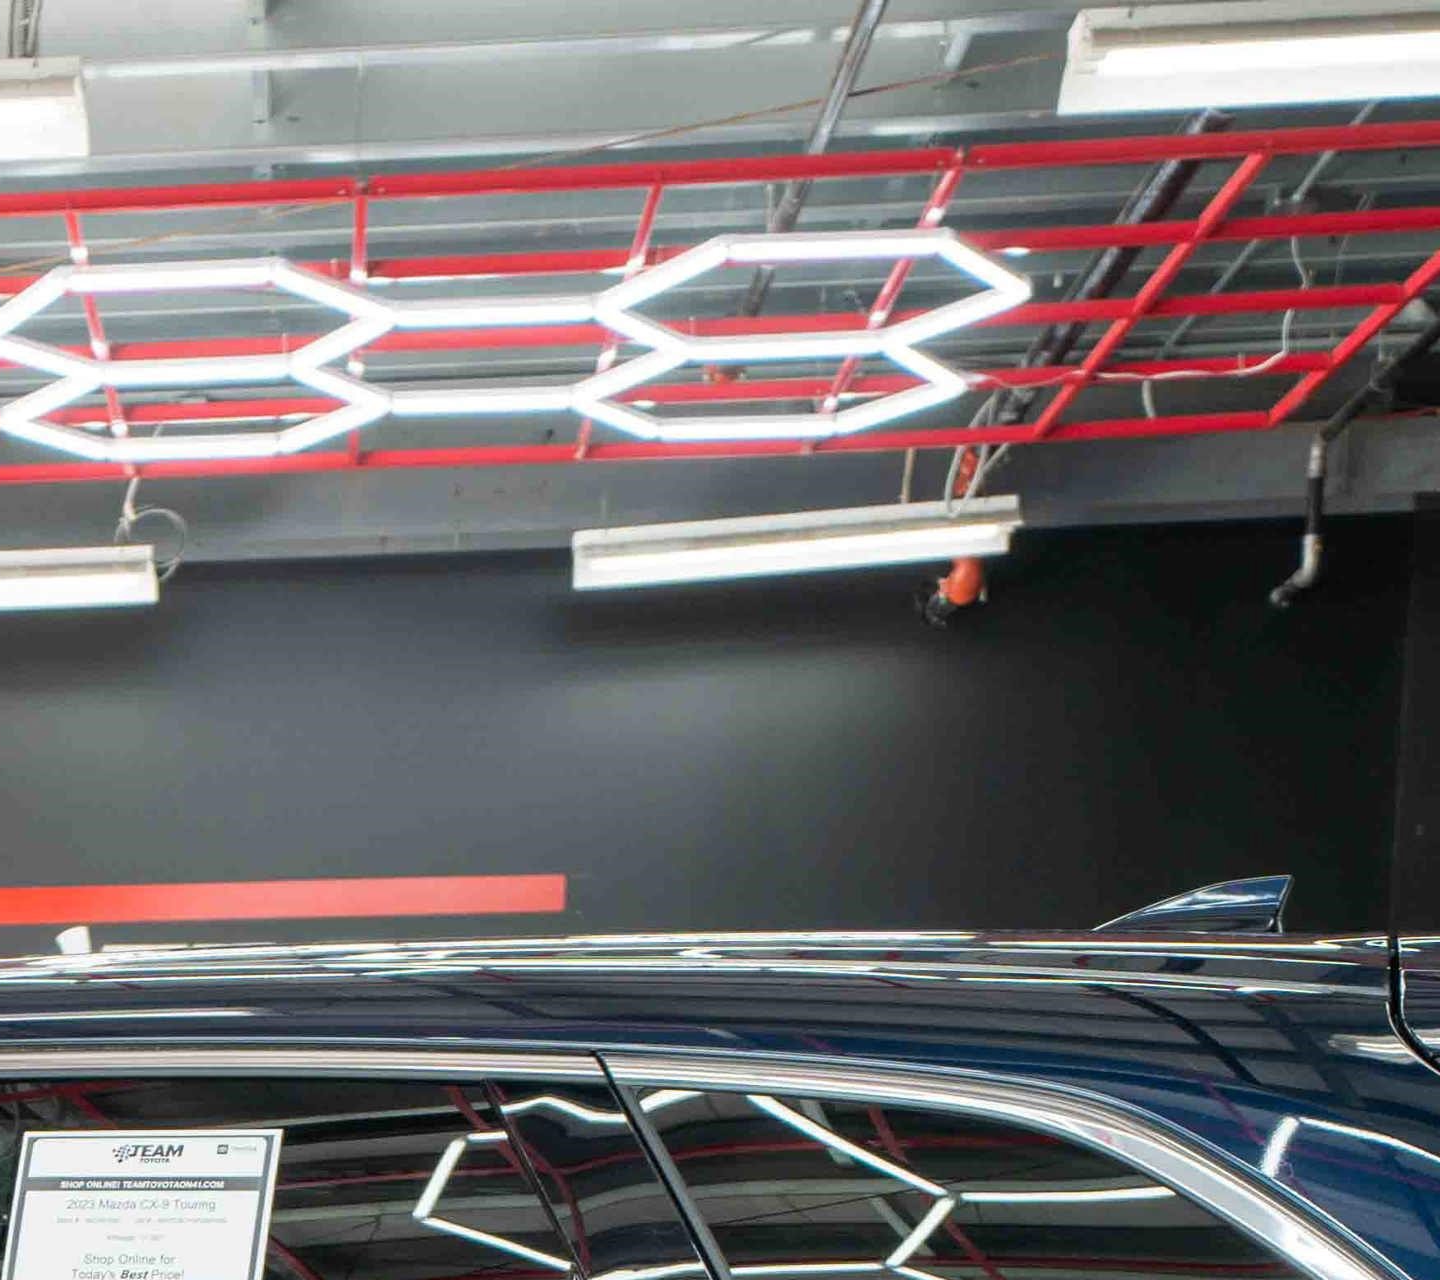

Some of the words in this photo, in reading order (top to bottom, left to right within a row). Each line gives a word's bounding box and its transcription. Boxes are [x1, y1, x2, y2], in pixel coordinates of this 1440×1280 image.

[129, 1144, 185, 1158] TEAM
[60, 1180, 84, 1189] SHOP
[86, 1180, 120, 1189] ONLINE!
[66, 1199, 95, 1210] 2023
[98, 1199, 136, 1210] Mazda
[139, 1199, 170, 1210] CX-9
[174, 1199, 216, 1213] Touring
[83, 1254, 115, 1266] Shop
[118, 1254, 156, 1265] Online
[159, 1254, 176, 1265] for
[72, 1269, 116, 1280] Today's
[119, 1269, 149, 1280] Best
[151, 1269, 185, 1280] Price!
